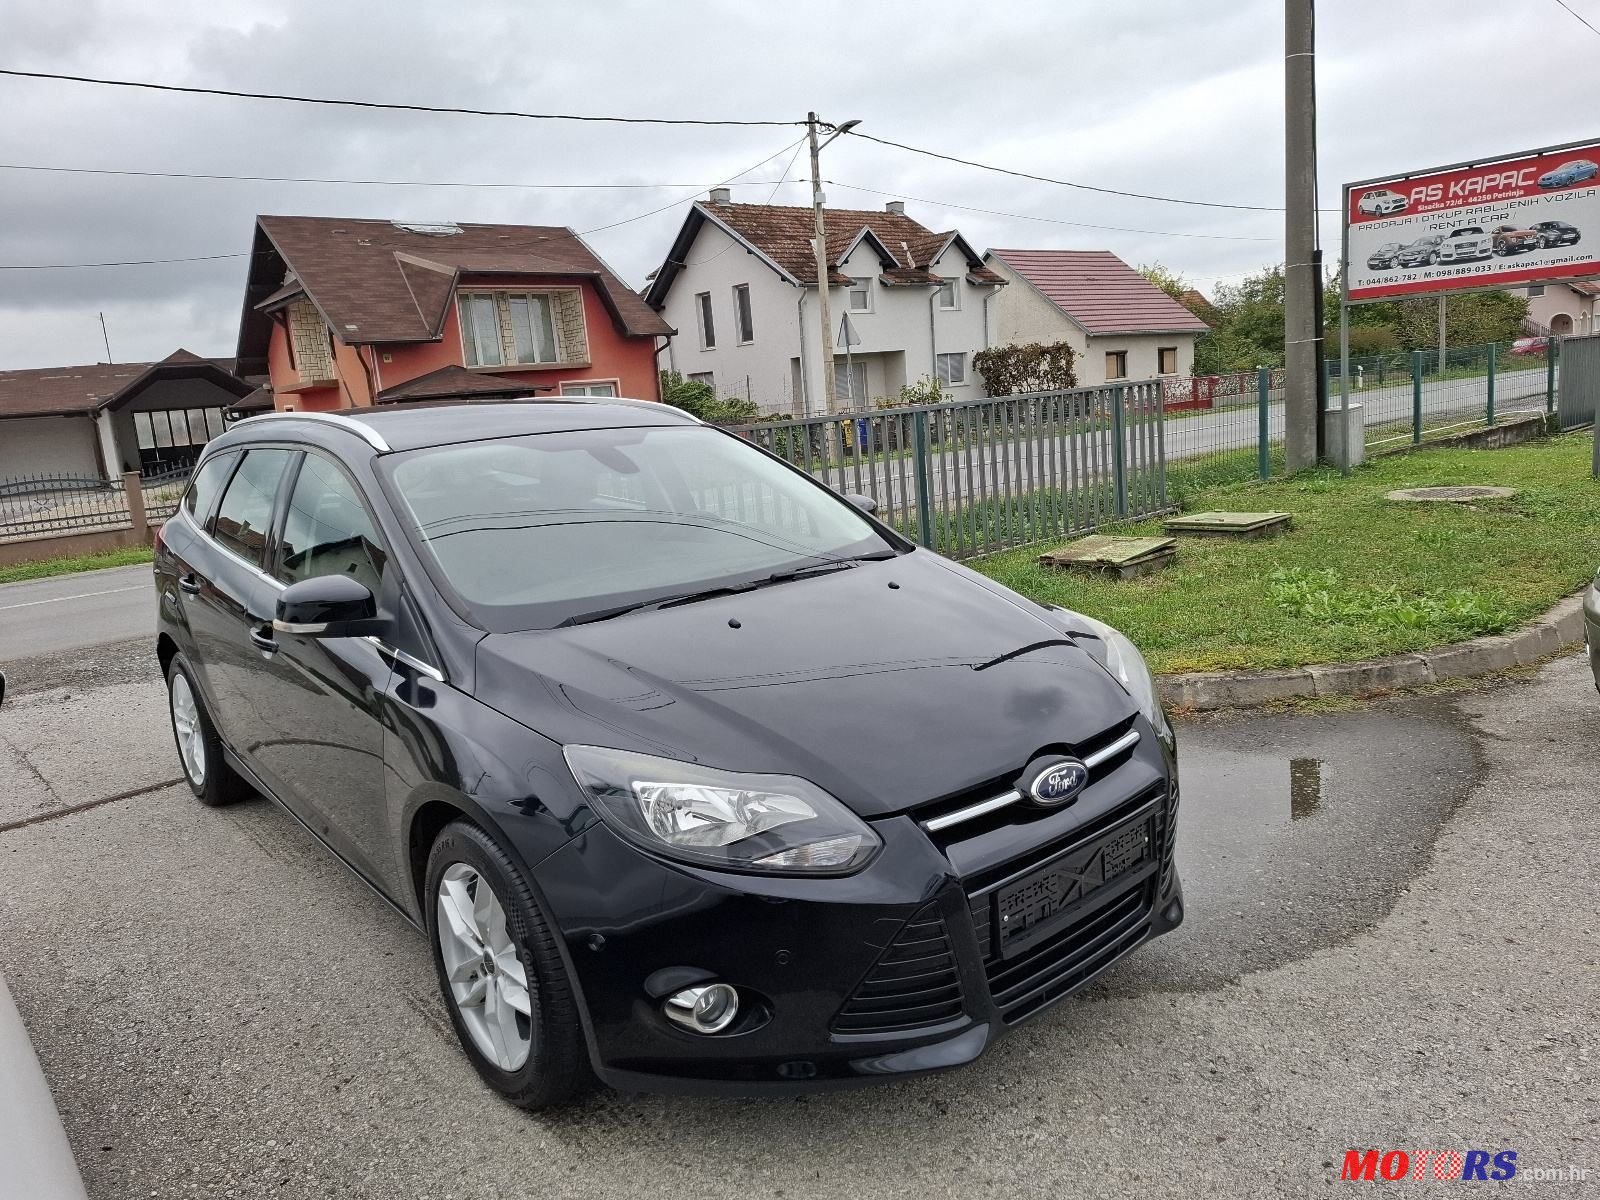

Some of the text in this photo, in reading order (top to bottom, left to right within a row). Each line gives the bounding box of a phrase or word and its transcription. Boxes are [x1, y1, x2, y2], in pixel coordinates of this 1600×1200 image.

[1410, 167, 1536, 204] AS KAPAC
[1446, 199, 1463, 207] 72/d
[1468, 194, 1491, 203] 44250
[1492, 189, 1524, 200] Petrinja
[1358, 218, 1412, 231] PRODAJA
[1421, 211, 1462, 222] OTKUP
[1466, 198, 1539, 215] RABLJENIH
[1544, 189, 1596, 202] VOZILA
[1429, 219, 1464, 231] RENT
[1467, 217, 1477, 225] A
[1480, 213, 1509, 224] CAR
[1366, 273, 1417, 286] 044/862-782
[1436, 264, 1492, 278] 098/889-033
[1507, 254, 1593, 270] askapac1@gmail.com
[1048, 769, 1077, 796] Ford
